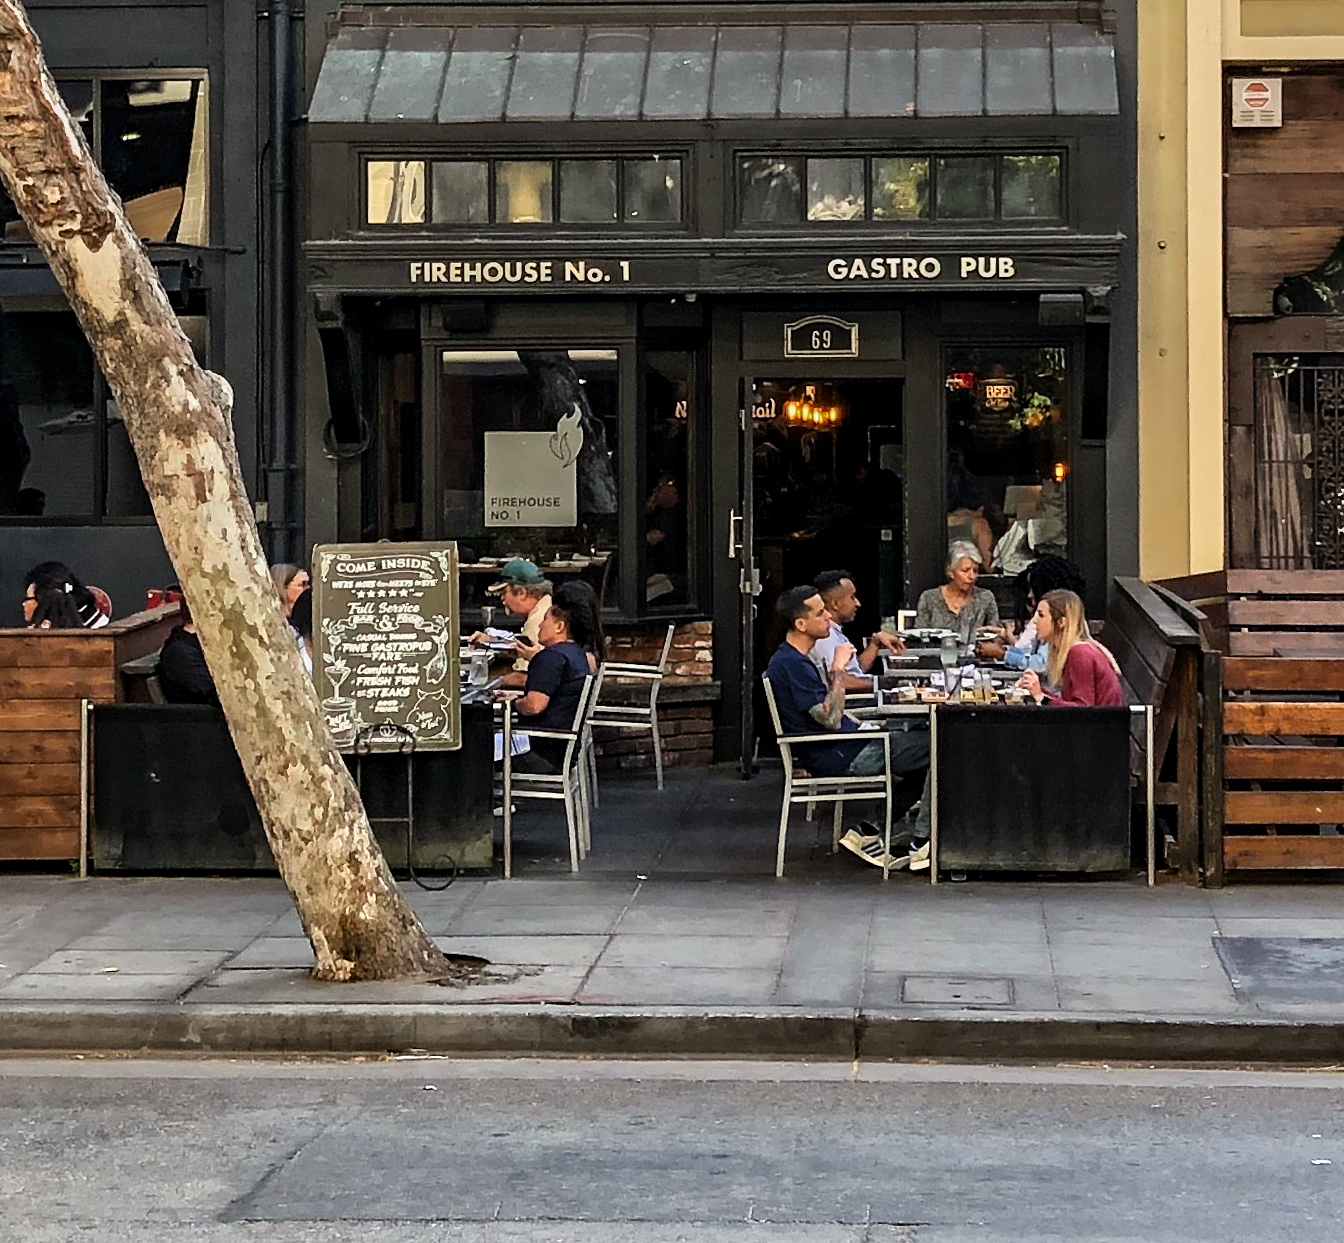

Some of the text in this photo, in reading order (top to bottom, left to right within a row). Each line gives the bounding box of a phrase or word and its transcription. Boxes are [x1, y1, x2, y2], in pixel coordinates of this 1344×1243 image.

[410, 261, 630, 283] FIREHOUSE No. 1
[827, 257, 1015, 280] GASTRO PUB
[812, 330, 832, 350] 69
[986, 385, 1017, 401] BEER
[491, 497, 561, 507] FIREHOUSE
[517, 510, 521, 520] 1
[336, 561, 376, 573] COME
[347, 602, 420, 614] Full Service
[356, 634, 387, 642] CASUAL
[342, 641, 432, 653] FINE GASTROPUB
[371, 652, 403, 661] FARE
[397, 663, 419, 674] Food
[356, 676, 420, 687] FRESH FISH
[366, 687, 411, 698] STEAKS
